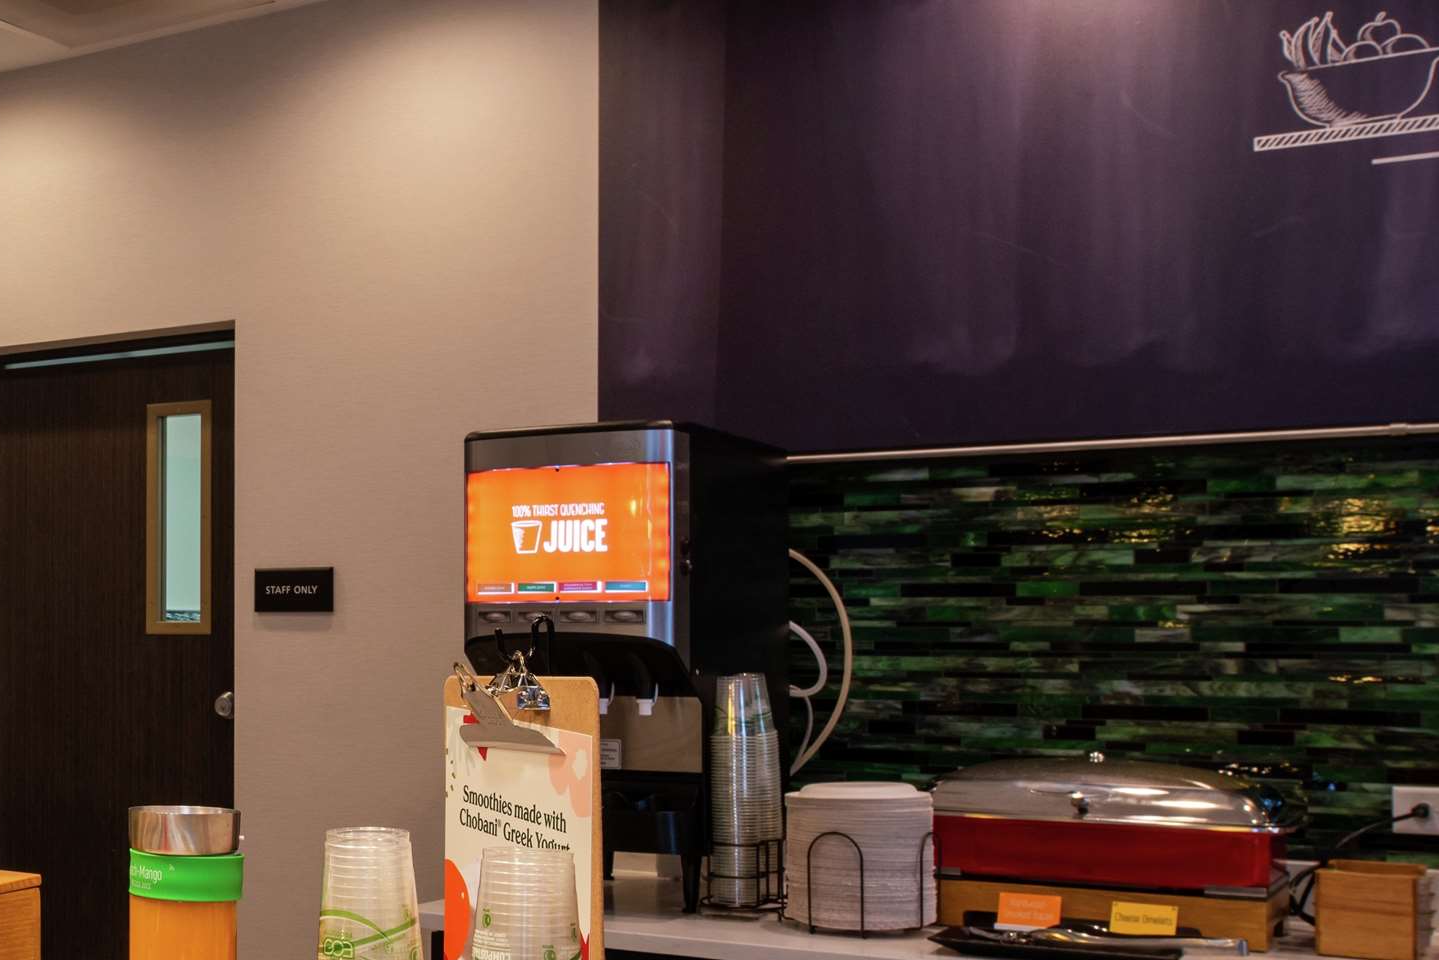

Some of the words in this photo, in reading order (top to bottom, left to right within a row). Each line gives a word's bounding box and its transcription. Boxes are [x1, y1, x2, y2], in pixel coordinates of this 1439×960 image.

[512, 505, 531, 517] 100%
[532, 504, 559, 516] THIRST
[560, 502, 605, 516] QUENCHING
[543, 518, 608, 553] JUICE
[265, 585, 291, 595] STAFF
[293, 585, 318, 594] ONLY
[462, 785, 513, 816] Smoothies
[514, 804, 542, 826] made
[543, 811, 567, 834] with
[503, 822, 533, 849] Greek
